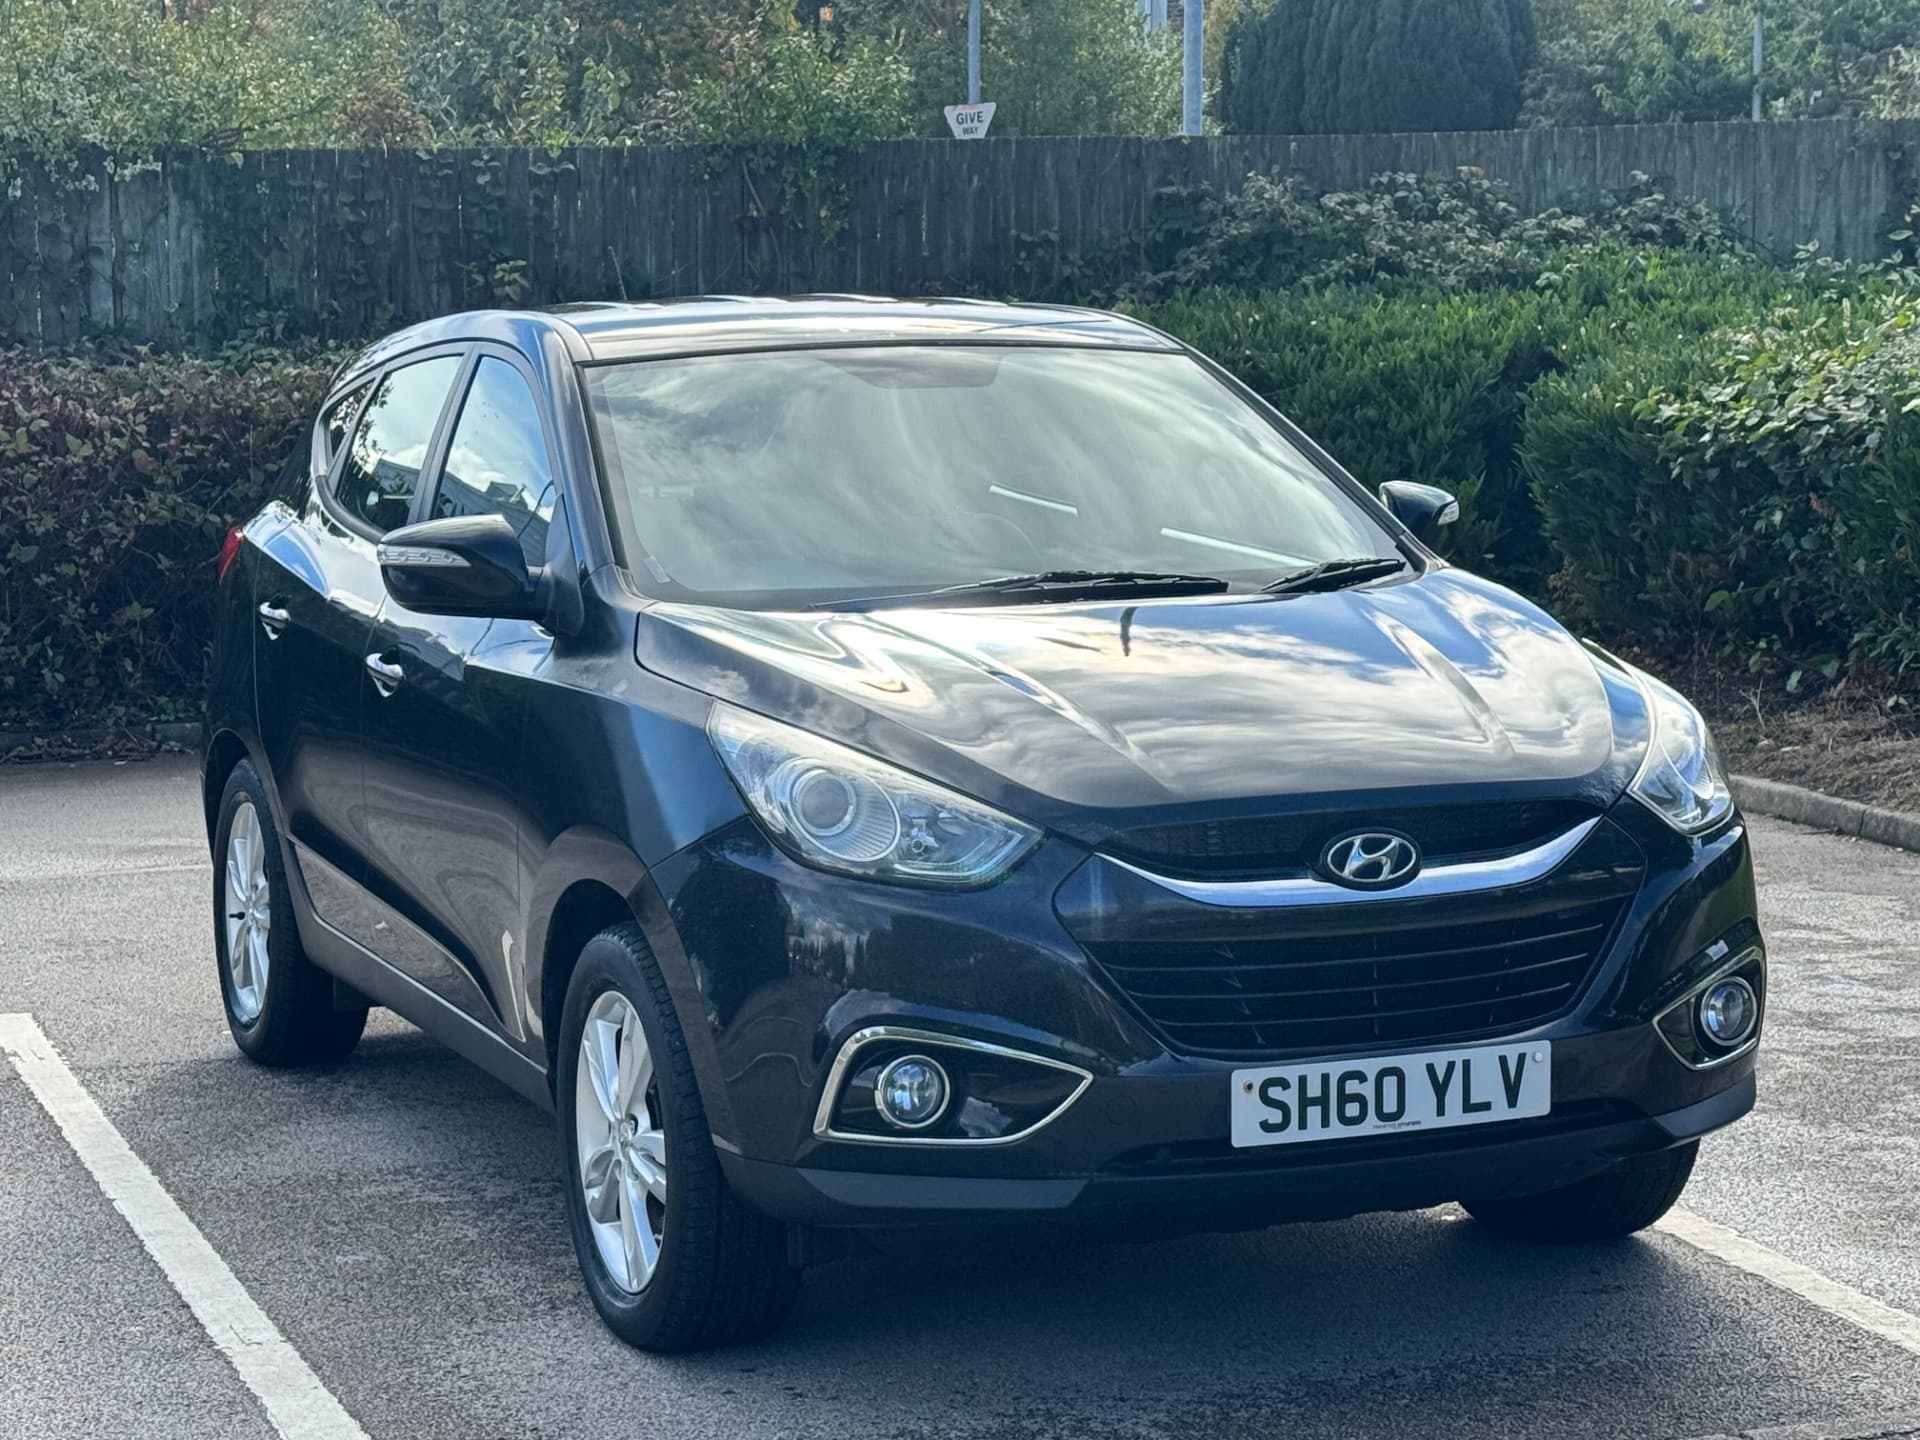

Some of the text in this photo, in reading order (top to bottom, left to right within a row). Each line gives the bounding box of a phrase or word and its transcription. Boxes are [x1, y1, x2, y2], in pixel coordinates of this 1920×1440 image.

[956, 111, 984, 125] GIVE
[962, 127, 979, 136] WAY
[1258, 1052, 1527, 1133] SH60 YLV
